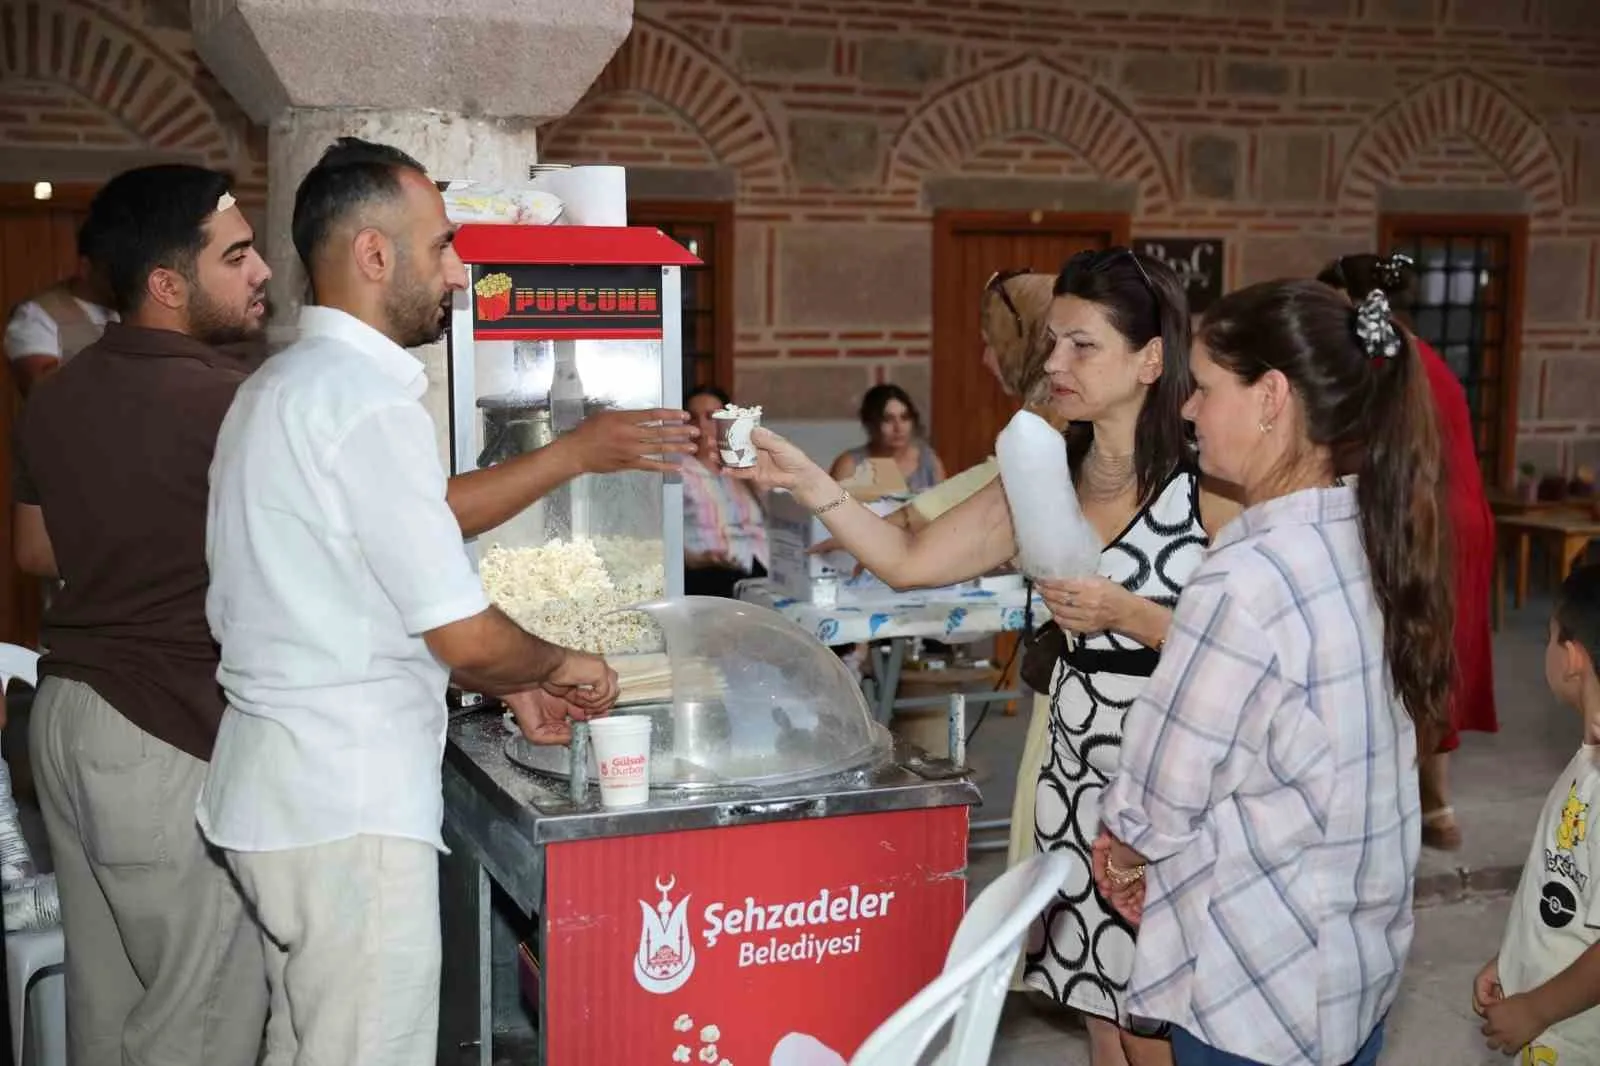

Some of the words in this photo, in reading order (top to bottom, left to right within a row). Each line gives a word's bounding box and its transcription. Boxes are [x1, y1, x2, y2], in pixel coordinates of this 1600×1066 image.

[515, 288, 657, 311] POPCORN
[702, 885, 895, 947] Şehzadeler
[738, 928, 861, 967] Belediyesi
